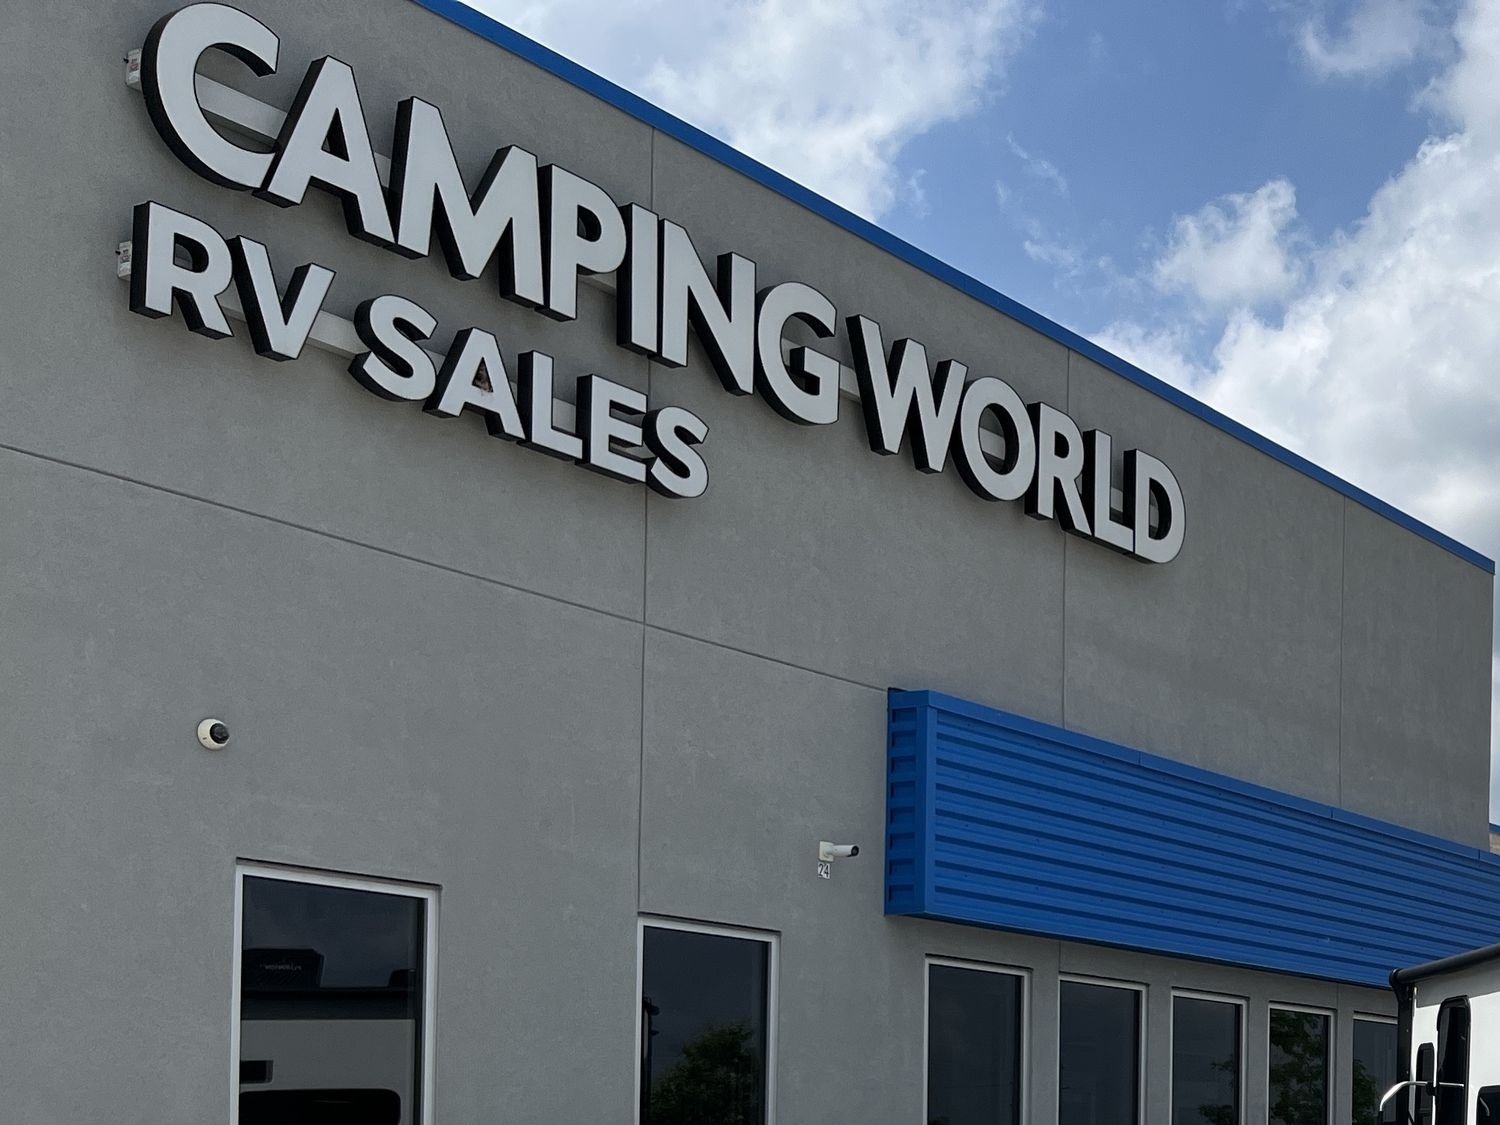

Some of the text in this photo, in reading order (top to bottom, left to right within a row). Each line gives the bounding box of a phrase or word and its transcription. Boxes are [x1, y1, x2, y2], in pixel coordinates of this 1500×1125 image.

[131, 200, 710, 501] RV SALES
[142, 2, 1187, 566] CAMPING WORLD
